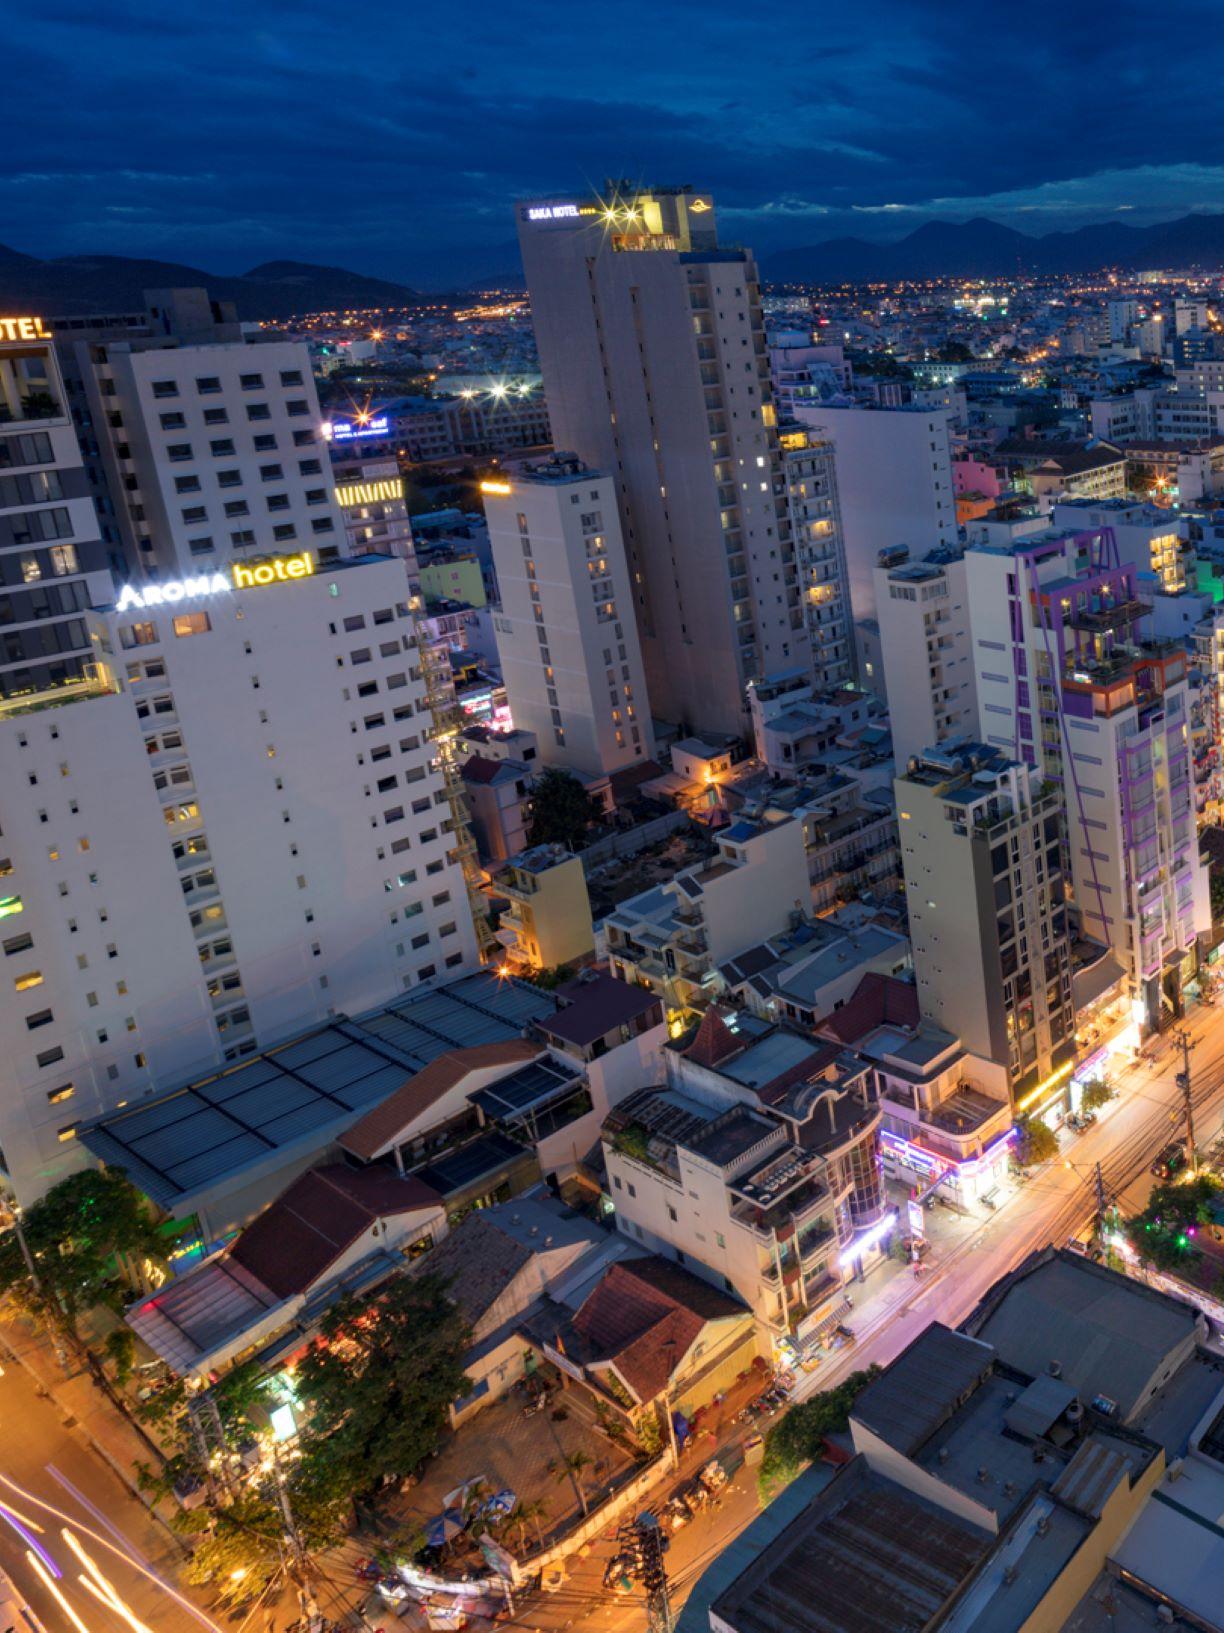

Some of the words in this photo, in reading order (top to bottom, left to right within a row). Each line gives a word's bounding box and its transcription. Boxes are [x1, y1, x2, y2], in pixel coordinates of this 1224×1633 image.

[552, 204, 579, 217] HOTEL
[0, 317, 52, 340] TEL
[115, 573, 231, 612] AROMA
[233, 552, 313, 588] hotel
